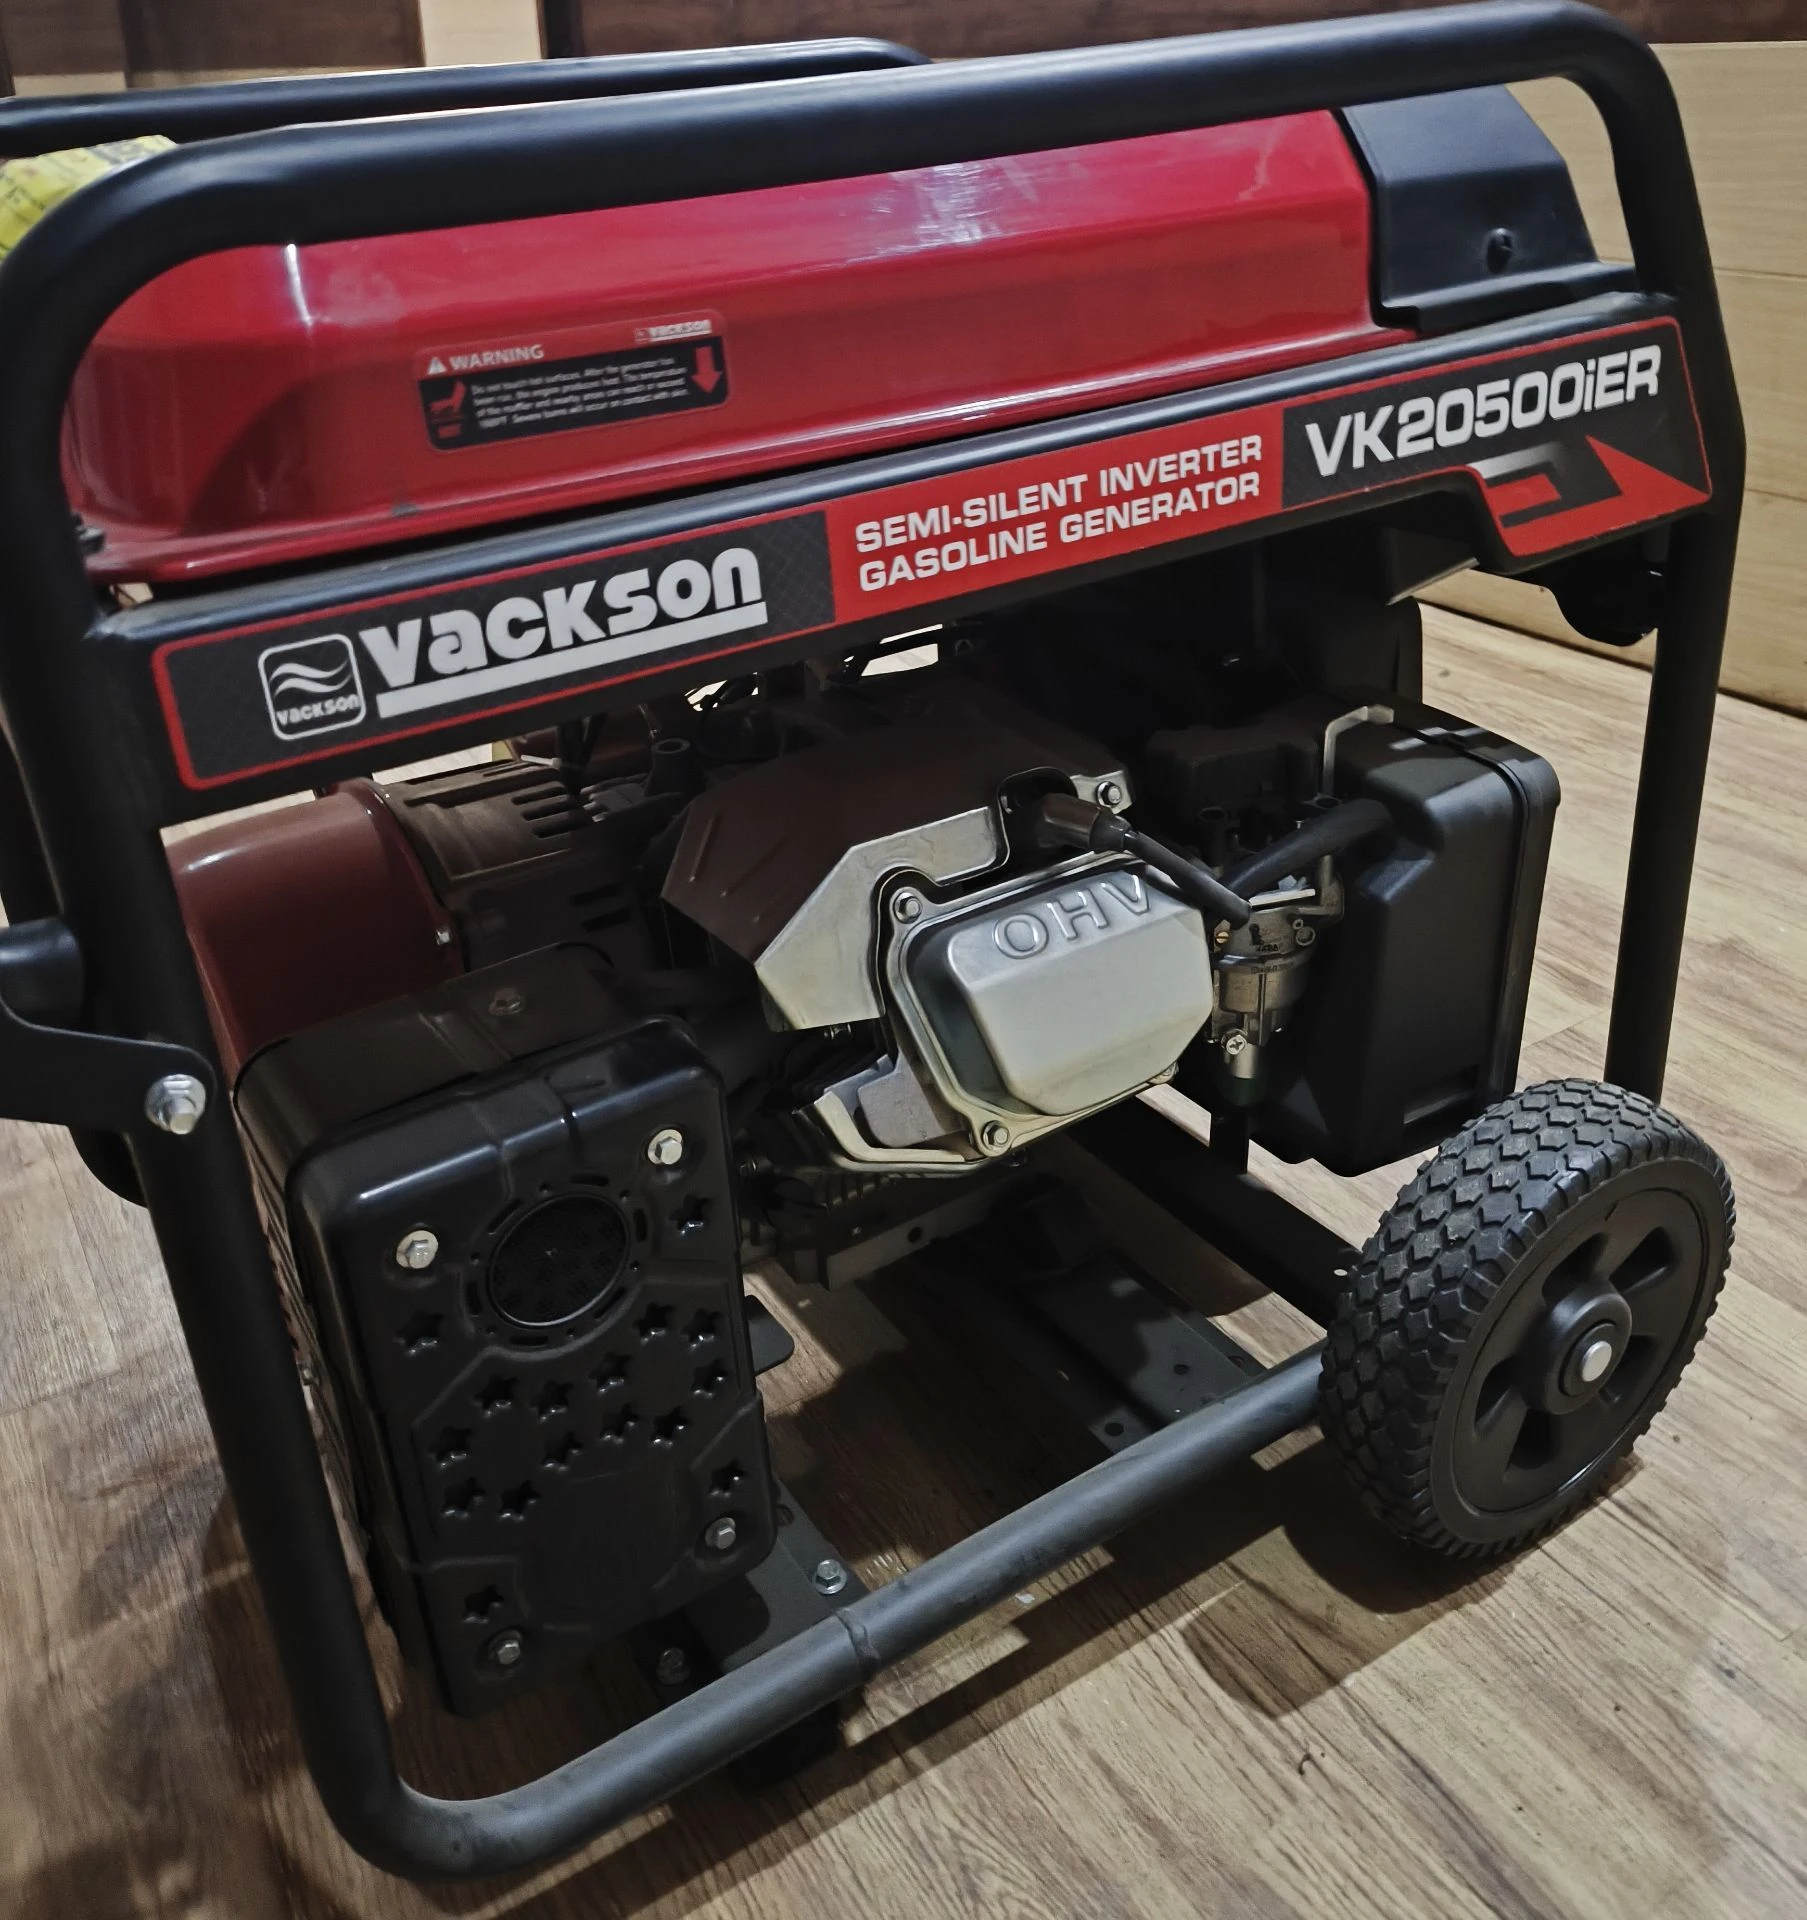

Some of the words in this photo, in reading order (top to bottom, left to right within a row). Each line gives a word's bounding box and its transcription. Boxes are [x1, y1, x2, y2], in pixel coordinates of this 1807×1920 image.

[448, 343, 545, 371] WARNING
[1304, 344, 1662, 478] VK20500iER
[854, 474, 1089, 553] SEMI-SILENT
[1099, 434, 1263, 497] INVERTER
[858, 522, 1049, 592] GASOLINE
[1059, 471, 1260, 543] GENERATOR
[992, 873, 1150, 960] OHV
